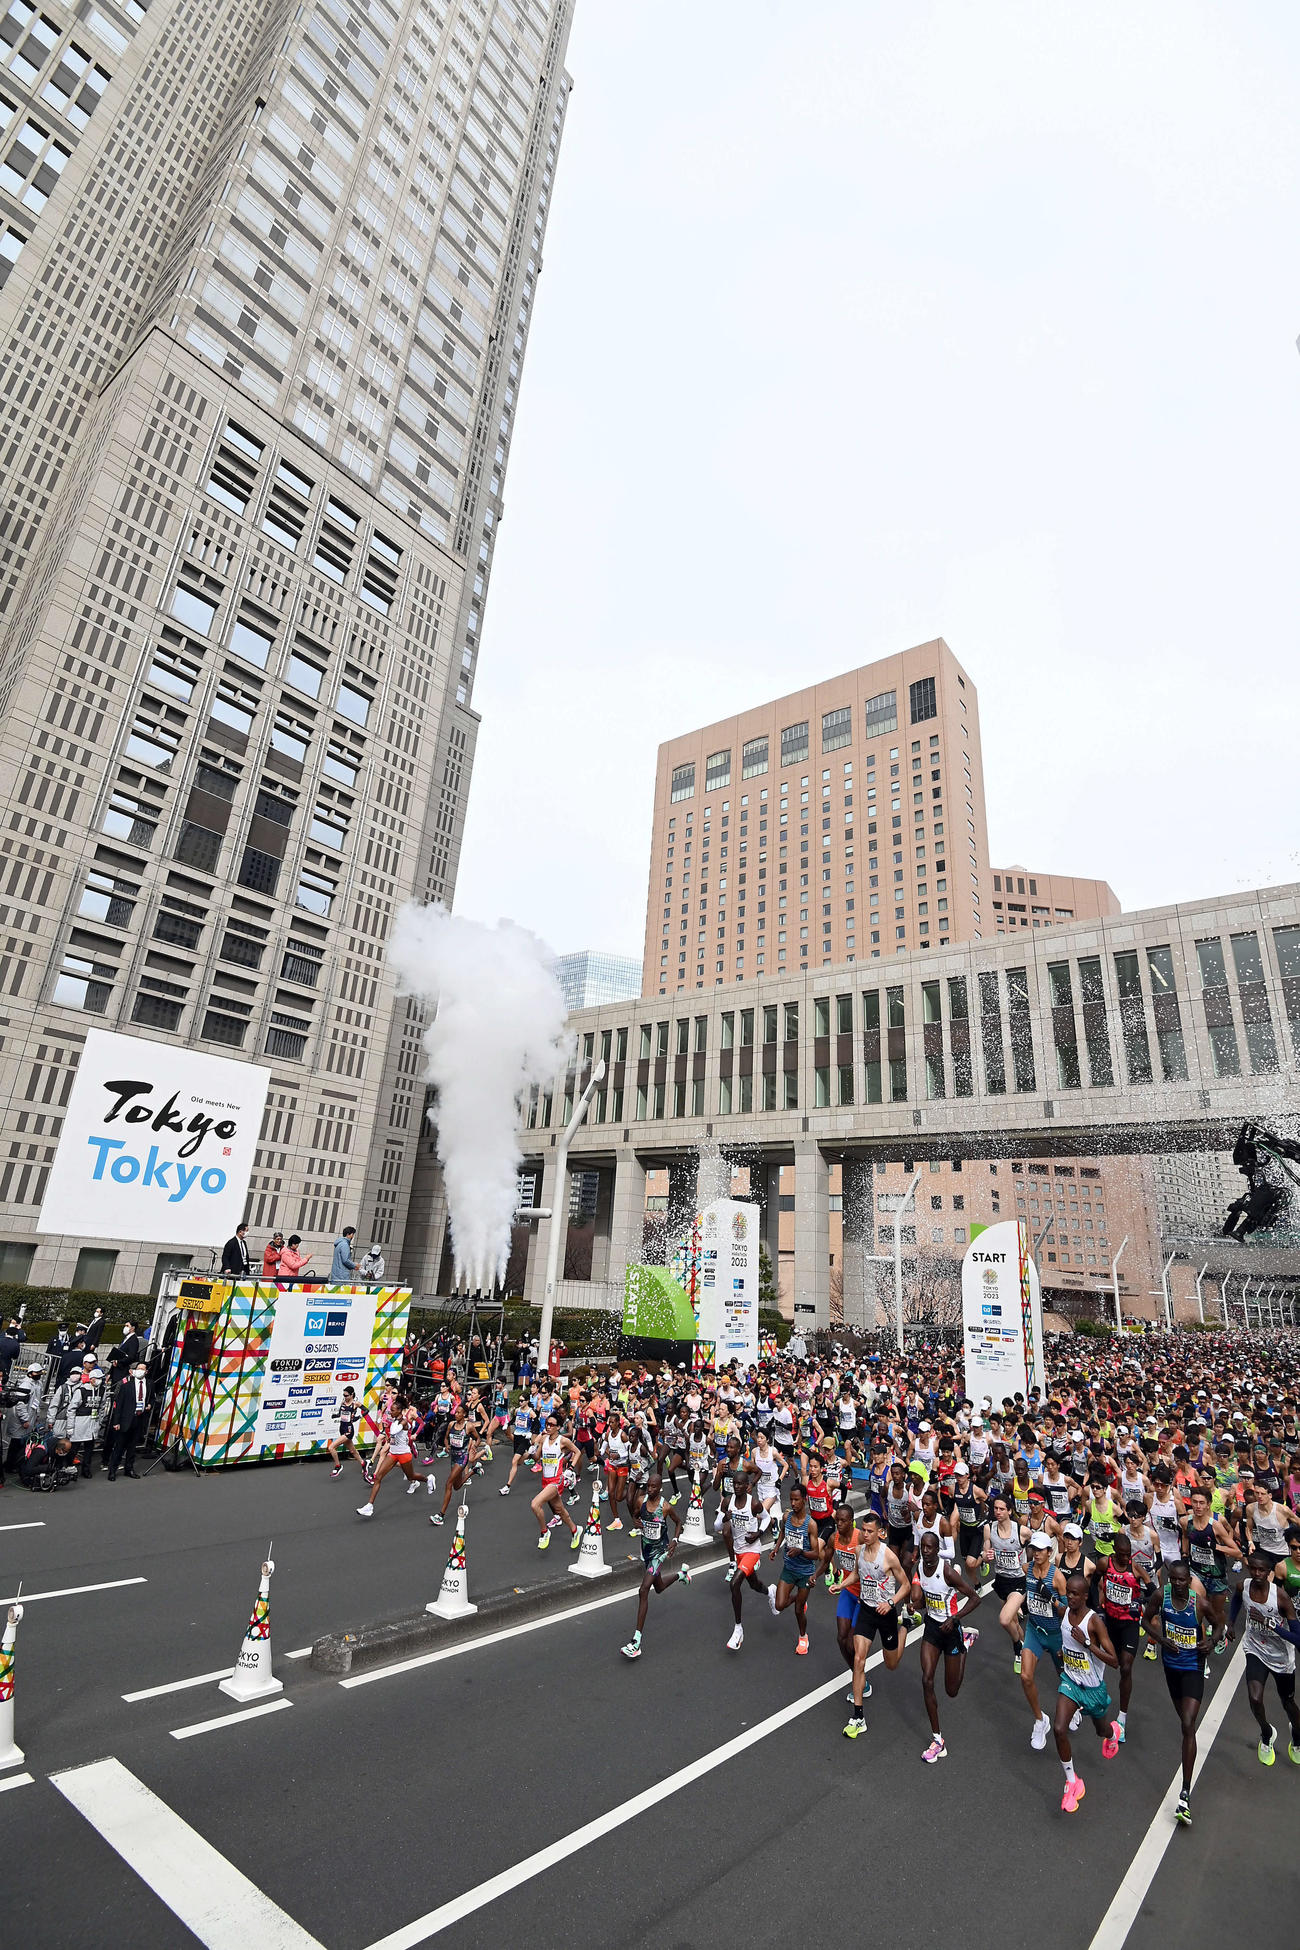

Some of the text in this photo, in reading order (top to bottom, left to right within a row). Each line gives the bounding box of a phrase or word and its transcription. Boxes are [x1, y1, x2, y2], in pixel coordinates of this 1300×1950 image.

[190, 1096, 241, 1111] Old meets New
[103, 1080, 237, 1158] Tokyo
[88, 1136, 227, 1203] Tokyo
[731, 1243, 747, 1252] TOKYO
[731, 1257, 748, 1267] 2023
[972, 1252, 1007, 1263] START
[626, 1272, 640, 1327] START
[983, 1292, 999, 1300] 2023
[182, 1298, 205, 1310] SEIKO
[274, 1359, 300, 1367] TOKIO
[315, 1361, 332, 1369] asics
[304, 1374, 331, 1383] SEIKO
